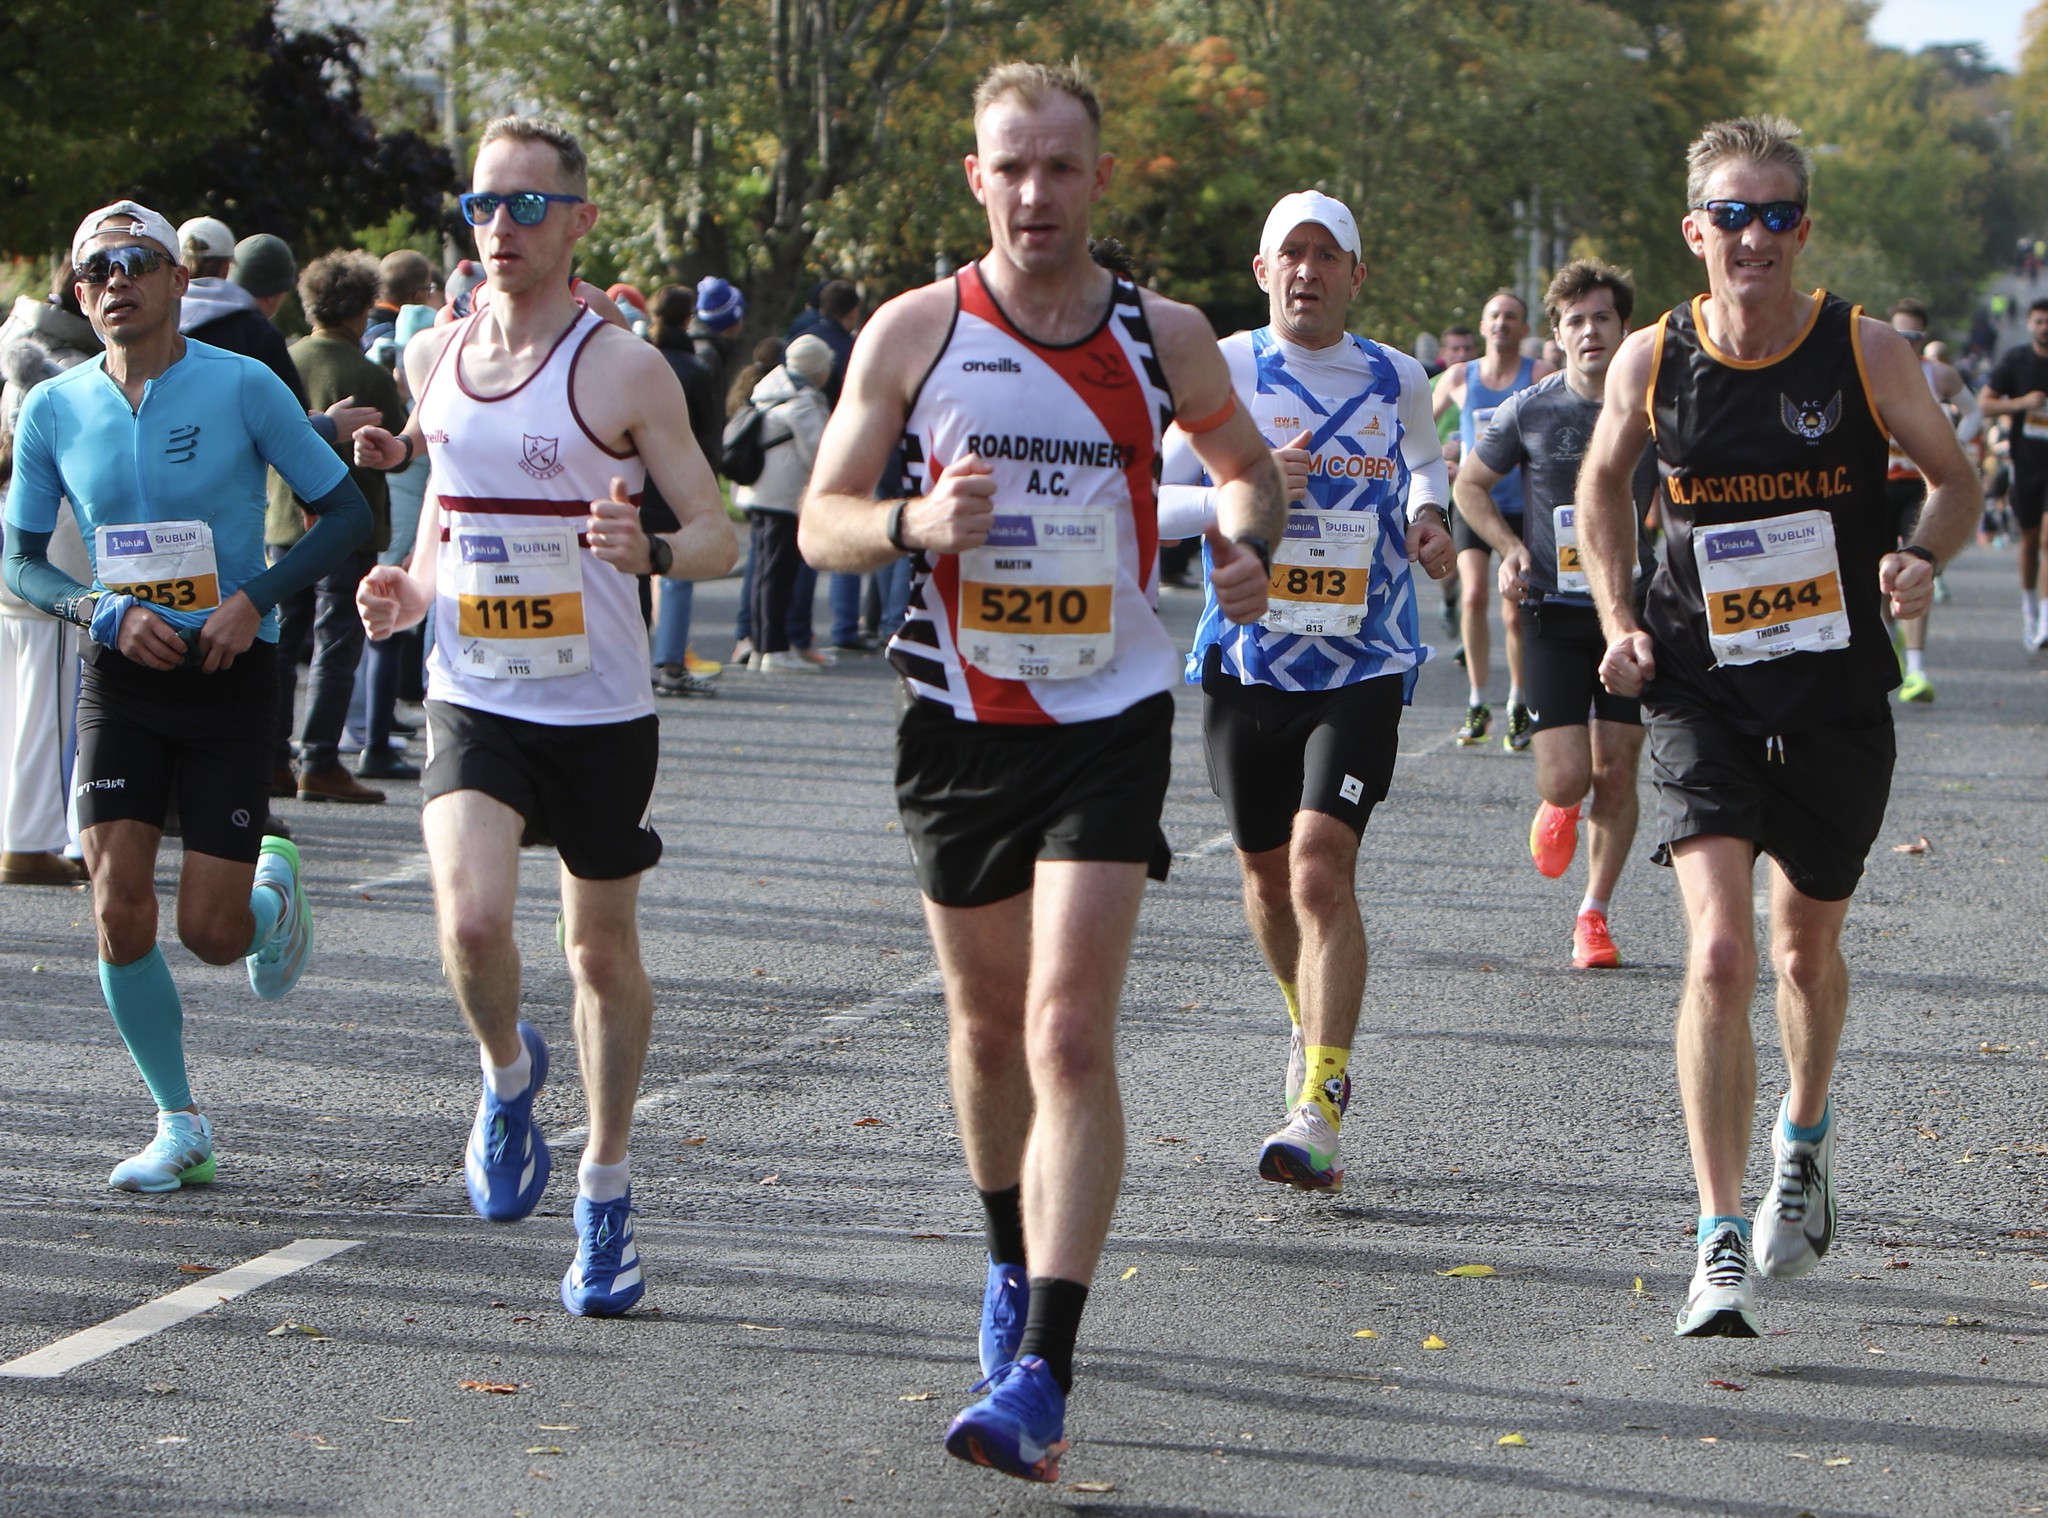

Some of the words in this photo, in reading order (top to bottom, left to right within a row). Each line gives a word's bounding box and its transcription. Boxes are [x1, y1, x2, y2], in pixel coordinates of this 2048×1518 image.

[967, 434, 1136, 469] ROADRUNNERS
[1327, 455, 1397, 480] COBEY
[1026, 469, 1070, 497] A.C.
[1667, 470, 1813, 505] BLACKROCK
[1816, 465, 1852, 499] A.C.
[1010, 526, 1028, 537] Life
[1043, 523, 1096, 536] DUBLIN
[1286, 523, 1301, 531] Irish
[1302, 523, 1315, 532] Life
[1325, 521, 1365, 533] DUBLIN
[155, 531, 197, 544] DUBLIN
[1767, 526, 1815, 544] DUBLIN
[120, 540, 133, 549] Irish
[134, 538, 145, 548] Life
[512, 542, 561, 554] DUBLIN
[1721, 540, 1739, 550] Irish
[1740, 539, 1755, 549] Life
[471, 544, 487, 555] Irish
[487, 545, 500, 556] Life
[1309, 548, 1325, 557] TOM
[994, 559, 1032, 570] MARTIN
[495, 575, 520, 585] JAMES
[1287, 568, 1347, 597] 813
[980, 588, 1088, 624] 5210
[1723, 581, 1821, 625] 5644
[476, 598, 554, 629] 1115
[1305, 624, 1323, 633] 813
[1756, 623, 1790, 640] THOMAS
[508, 665, 530, 675] 1115
[1018, 664, 1049, 675] 5210
